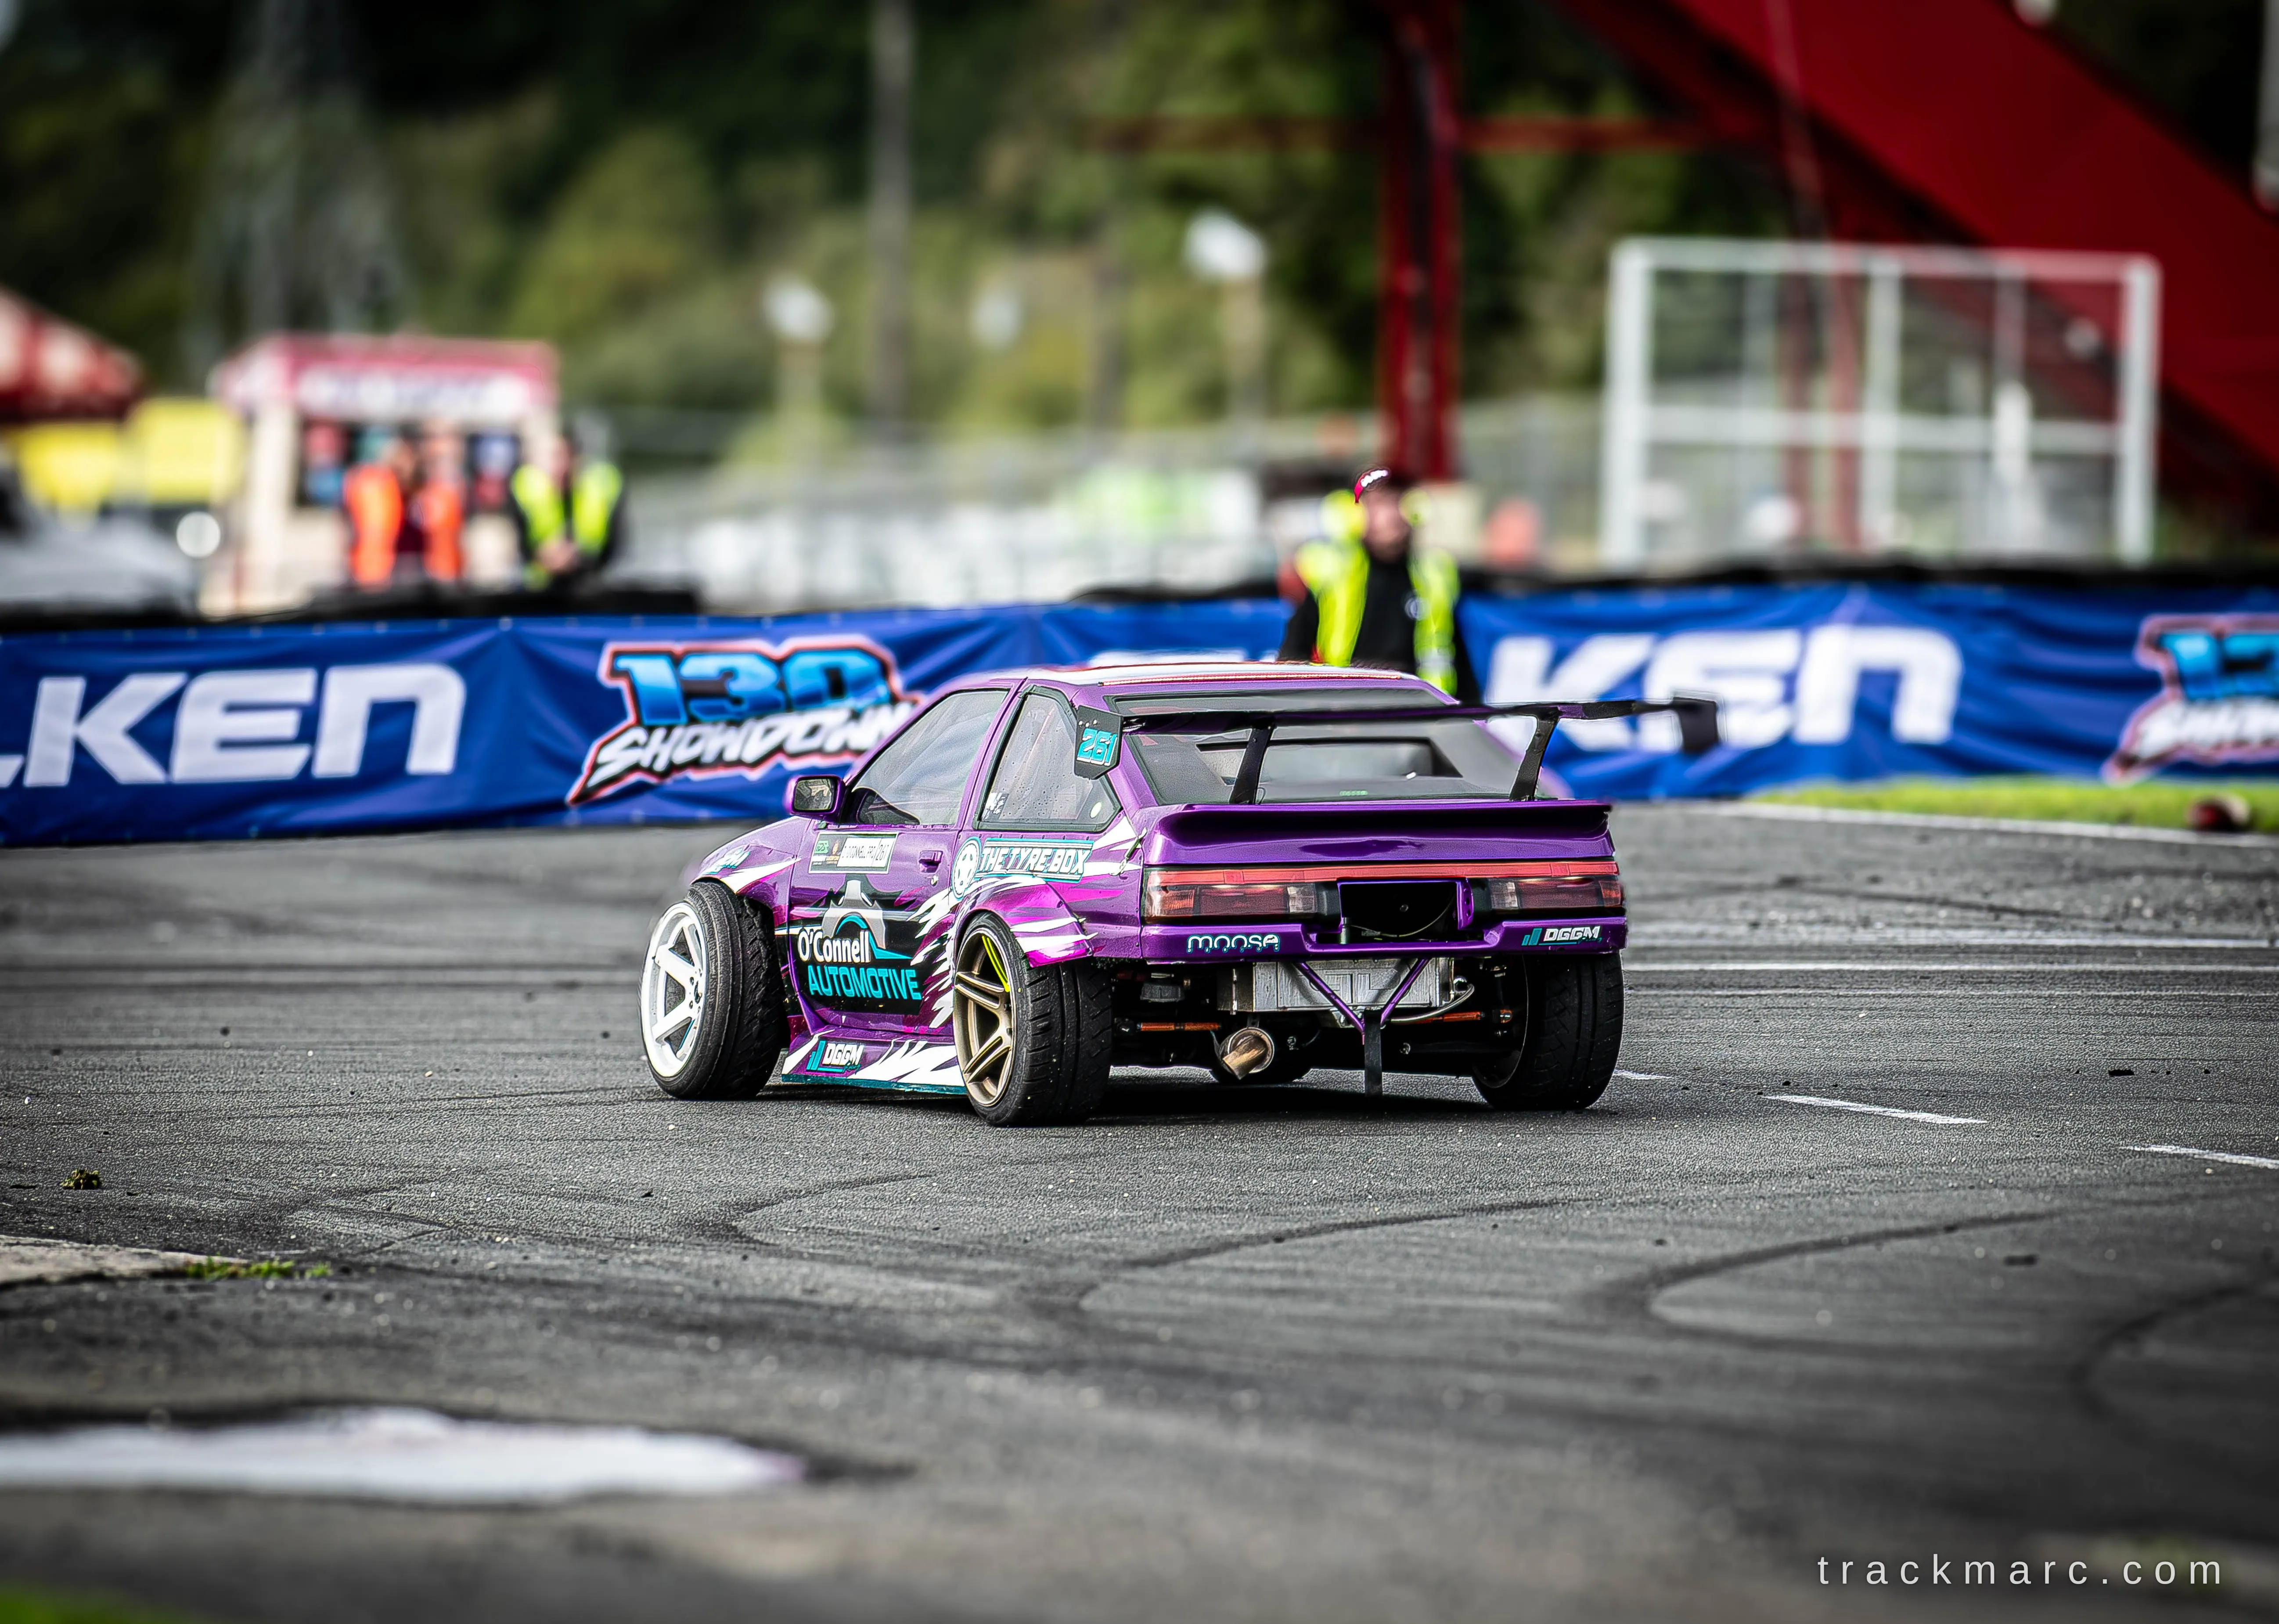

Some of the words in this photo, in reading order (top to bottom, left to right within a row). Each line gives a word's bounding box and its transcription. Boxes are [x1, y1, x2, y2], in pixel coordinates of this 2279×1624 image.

[614, 648, 891, 726] 130
[1076, 728, 1118, 766] 261
[979, 847, 1009, 872] THE
[1006, 847, 1053, 871] TYRE
[1051, 848, 1091, 874] BOX
[798, 930, 871, 963] O'Connell
[1543, 926, 1600, 942] DGGM
[808, 965, 922, 1000] AUTOMOTIVE
[822, 1043, 864, 1066] DGGM
